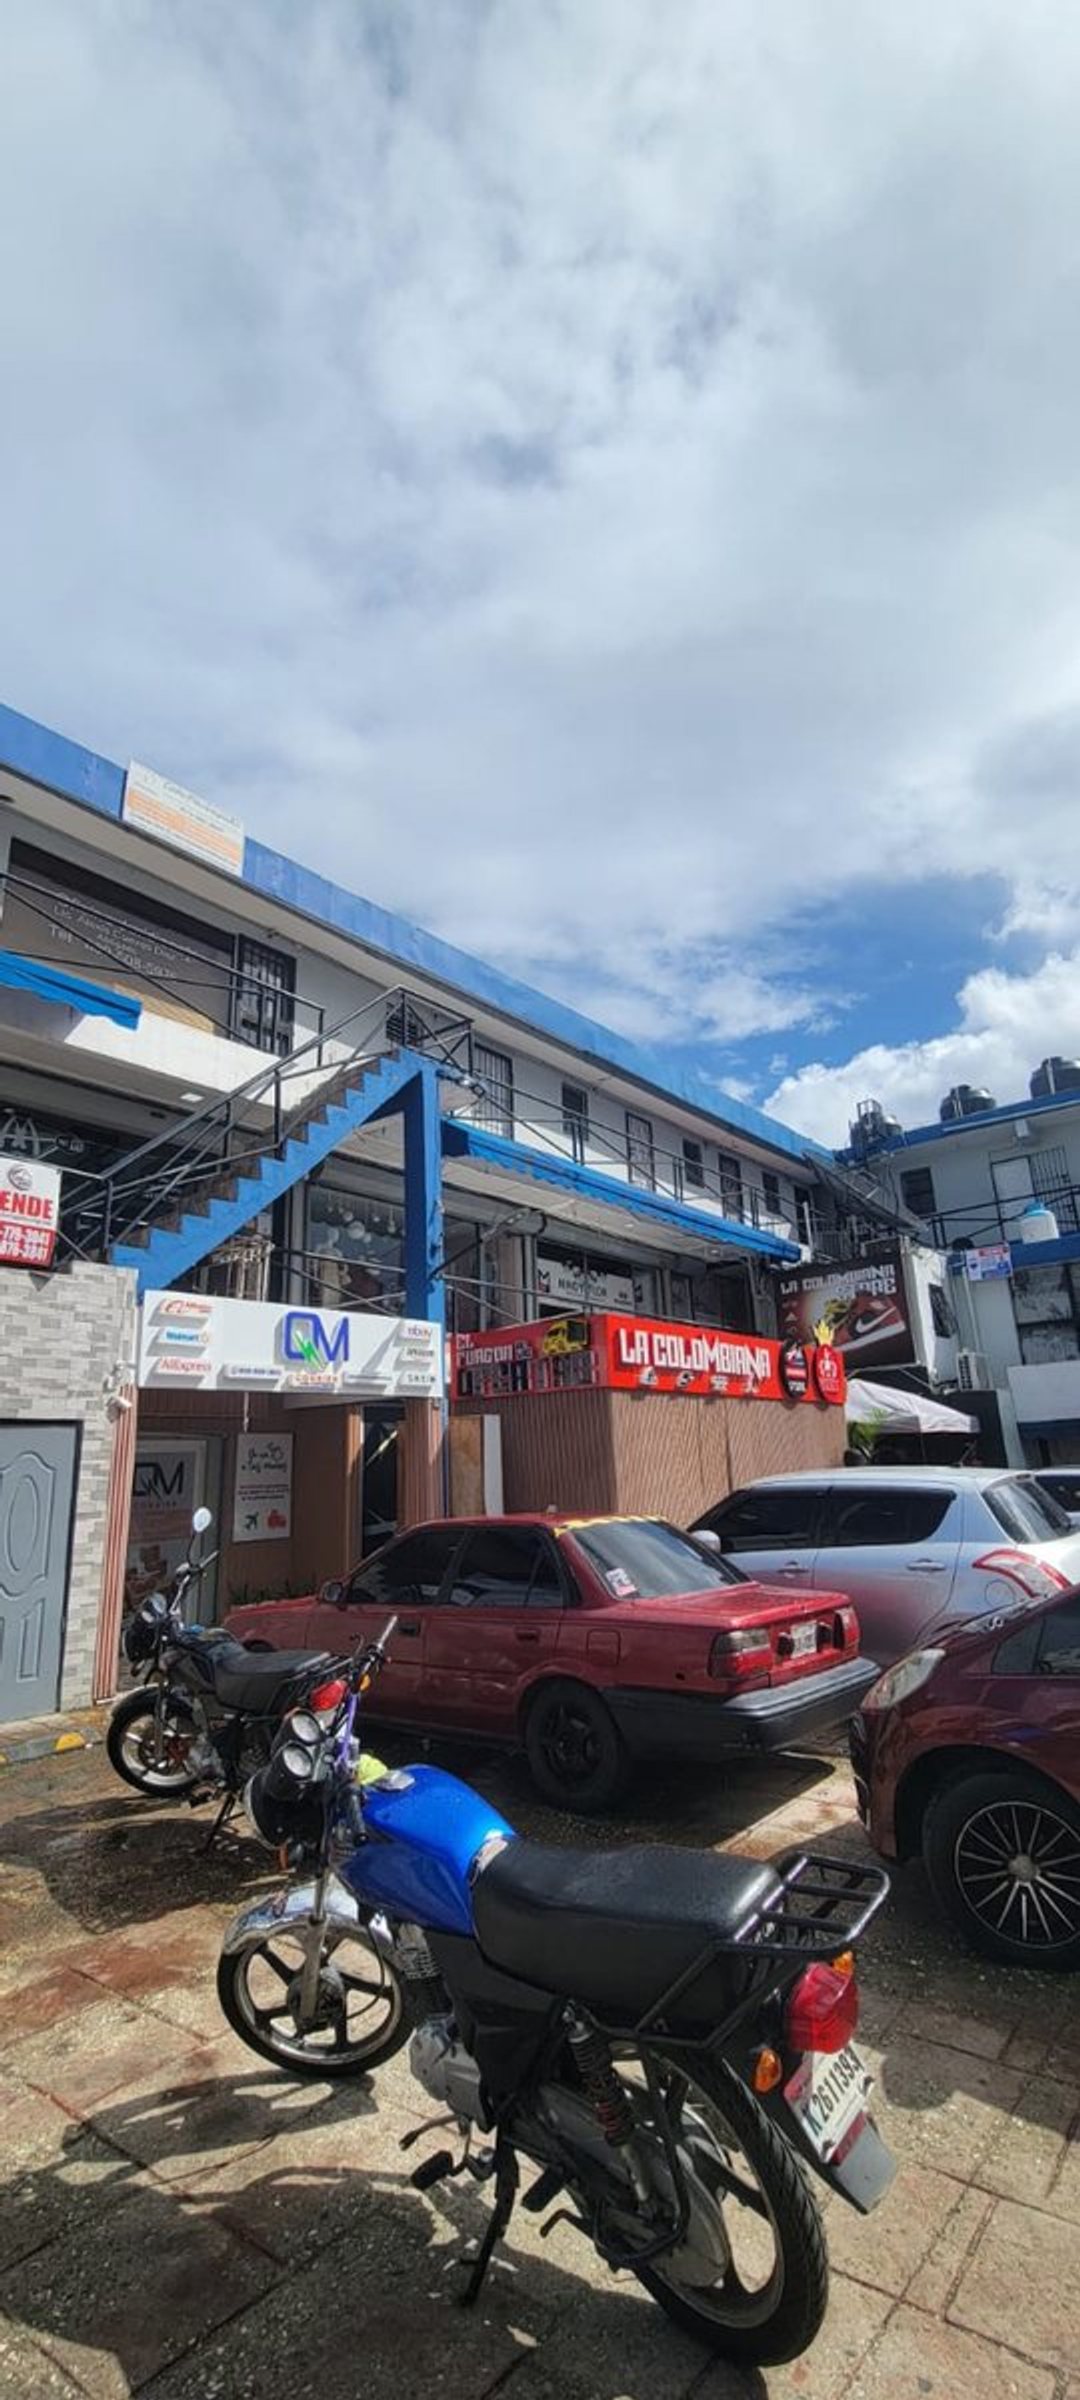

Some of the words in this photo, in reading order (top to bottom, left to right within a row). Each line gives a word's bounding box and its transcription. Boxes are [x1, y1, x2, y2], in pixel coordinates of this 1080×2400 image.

[780, 1280, 798, 1295] LA
[802, 1264, 896, 1291] COLOMBIANA
[160, 1359, 211, 1372] AliExpress
[619, 1327, 649, 1365] LA
[652, 1333, 771, 1381] COLOMBIANA
